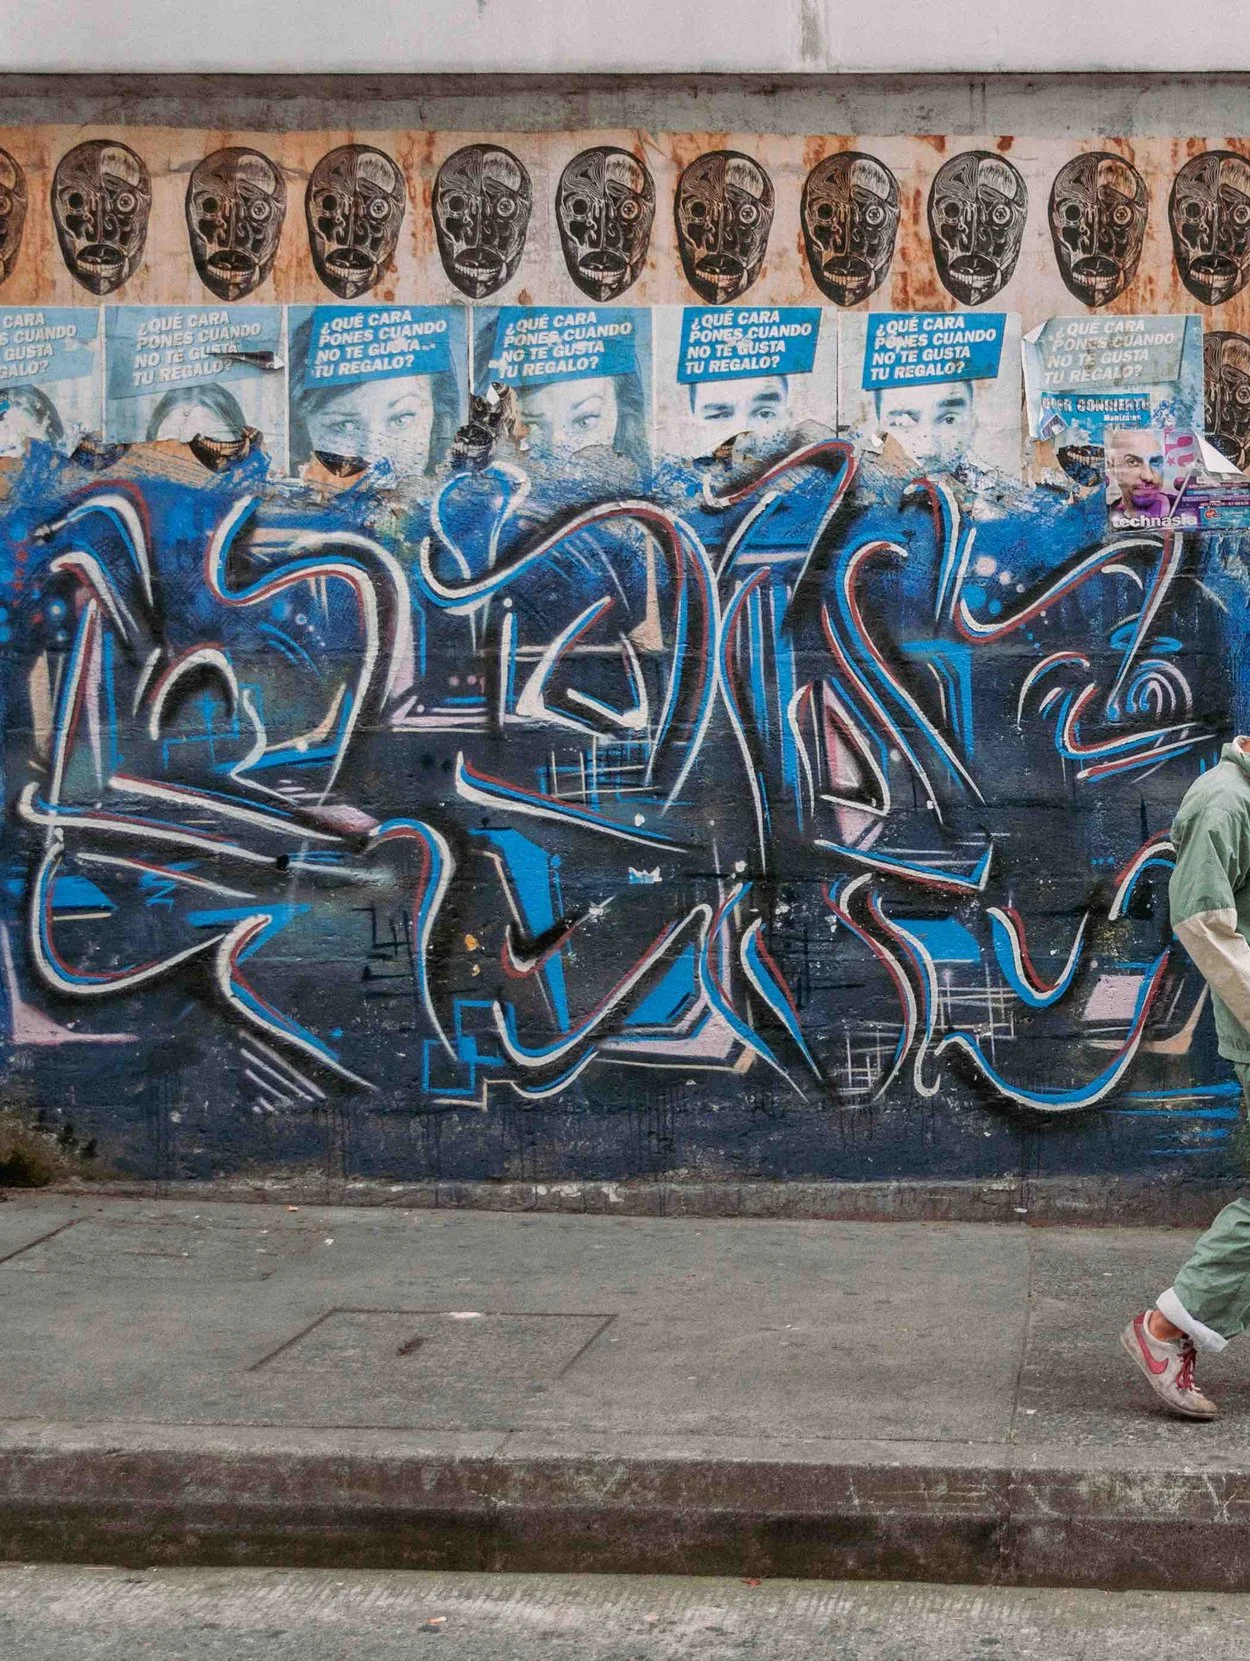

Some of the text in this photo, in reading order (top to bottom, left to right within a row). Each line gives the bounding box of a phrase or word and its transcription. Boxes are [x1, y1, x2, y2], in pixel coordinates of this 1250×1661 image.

[3, 312, 45, 328] CARA
[138, 311, 230, 337] ¿QUÉ CARA
[320, 310, 413, 335] ¿QUÉ CARA
[505, 311, 597, 335] ¿QUÉ CARA
[691, 309, 780, 331] ¿QUÉ CARA
[876, 315, 965, 337] ¿QUÉ CARA
[1055, 319, 1145, 339] ¿QUÉ CARA
[14, 325, 77, 344] CUANDO
[136, 323, 262, 350] PONES CUANDO
[319, 319, 447, 348] PONES CUANDO
[503, 321, 633, 348] PONES CUANDO
[689, 322, 812, 344] PONES CUANDO
[874, 328, 997, 350] PONES CUANDO
[1109, 332, 1174, 349] CUANDO
[133, 352, 161, 369] NO
[166, 348, 185, 364] TE
[316, 348, 341, 363] NO
[345, 345, 364, 360] TE
[501, 340, 605, 363] NO TE GUSTA
[686, 339, 786, 360] NO TE GUSTA
[872, 344, 971, 366] NO TE GUSTA
[1047, 354, 1073, 370] NO
[1100, 347, 1149, 364] GUSTA
[132, 359, 233, 387] TU REGALO?
[313, 354, 415, 379] TU REGALO?
[499, 356, 600, 379] TU REGALO?
[685, 354, 781, 375] TU REGALO?
[870, 360, 966, 381] TU REGALO?
[1045, 370, 1065, 385] TU
[1111, 512, 1198, 529] technasia
